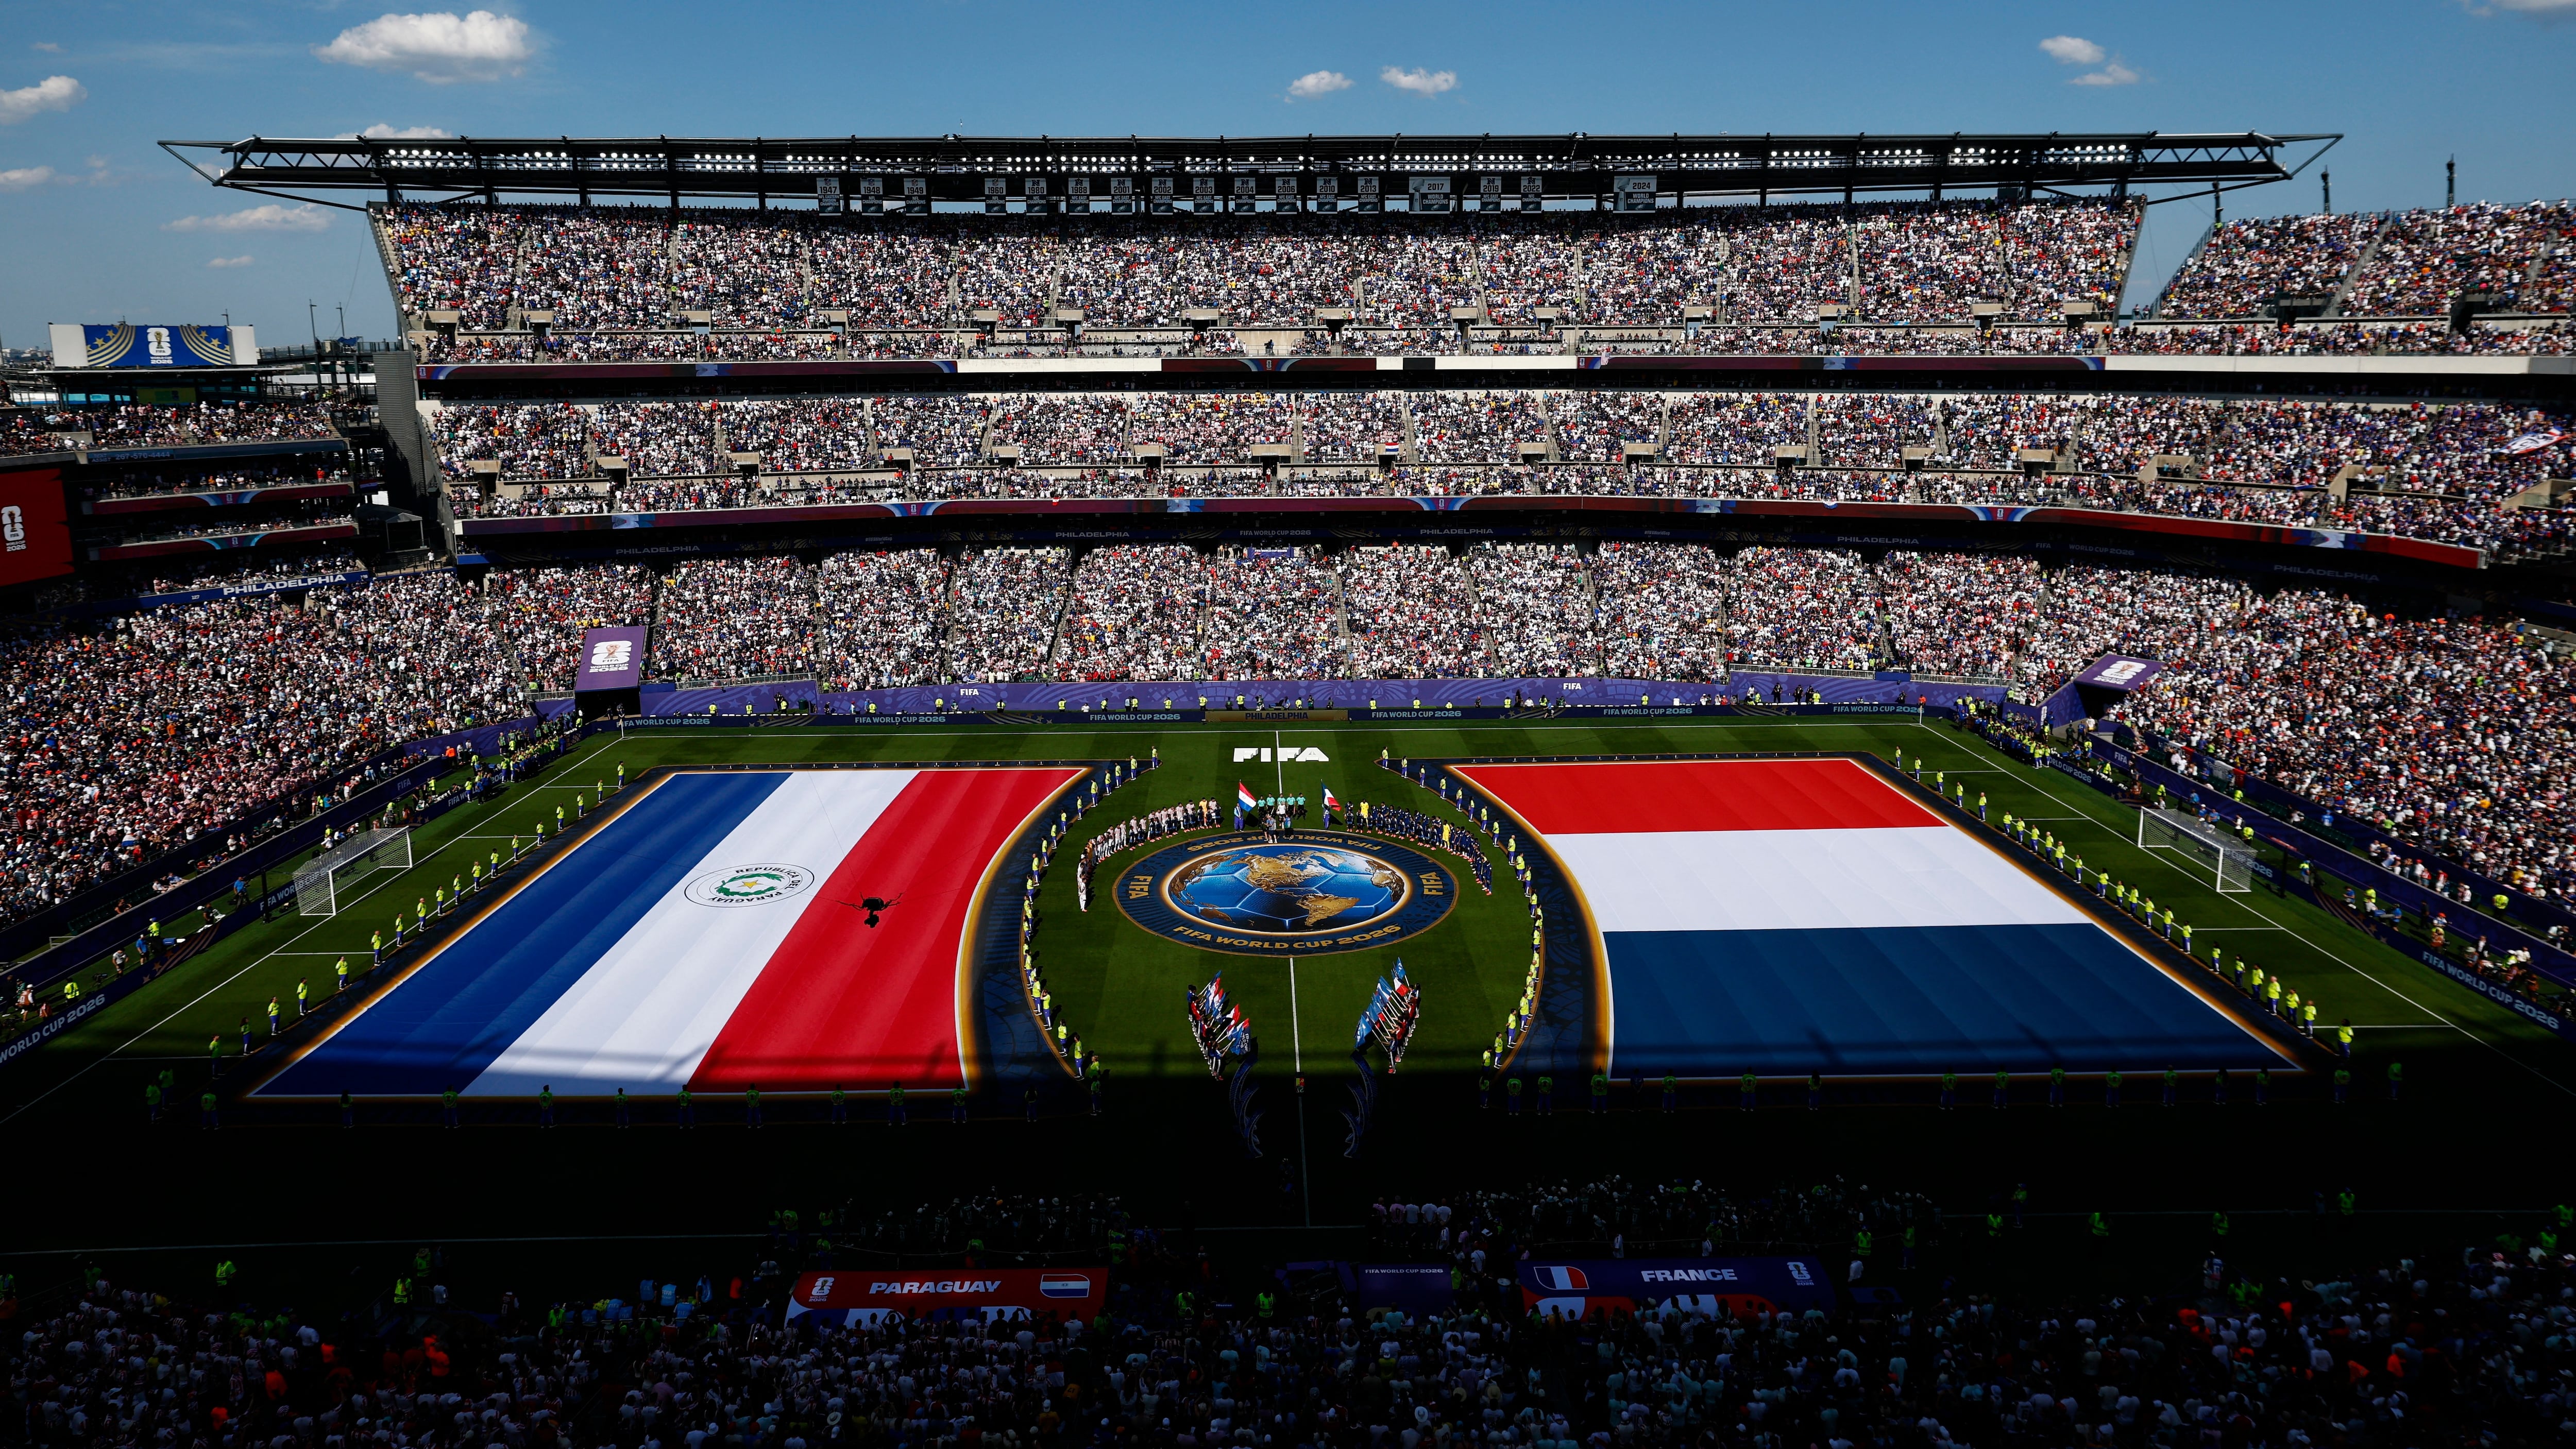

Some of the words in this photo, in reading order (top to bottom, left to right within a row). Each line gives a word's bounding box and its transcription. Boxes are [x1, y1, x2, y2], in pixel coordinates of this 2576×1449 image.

[1837, 536, 1920, 544] PHILADELPHIA
[2069, 543, 2094, 552] WORLD
[616, 545, 700, 555] PHILADELPHIA
[2274, 565, 2380, 582] PHILADELPHIA
[223, 574, 347, 595] PHILADELPHIA
[1233, 747, 1329, 762] FIFA
[2114, 751, 2128, 764] FIFA
[2049, 757, 2062, 769] ORLD
[2062, 763, 2074, 773] CUP
[2073, 769, 2092, 783] 2026
[397, 778, 411, 791] FIFA
[448, 795, 460, 807] FIFA
[1187, 837, 1245, 852] 2026
[735, 867, 799, 878] REPUBLICA
[2246, 858, 2273, 878] 2026
[785, 879, 800, 890] DEL
[1128, 875, 1154, 899] FIFA
[1419, 872, 1443, 895] FIFA
[259, 896, 277, 911] FFA
[708, 891, 783, 903] PARAGUAY
[1173, 926, 1212, 941] FIFA
[1215, 936, 1289, 949] WORLD
[1292, 939, 1334, 949] CUP
[1337, 926, 1402, 945] 2026
[2422, 951, 2445, 971] FIFA
[2446, 963, 2487, 992] WORLD
[2488, 986, 2514, 1004] CUP
[2513, 999, 2560, 1030] 2026
[42, 1016, 65, 1037] CUP
[66, 994, 106, 1024] 2026
[1641, 1269, 1738, 1282] FRANCE
[869, 1281, 1002, 1294] PARAGUAY
